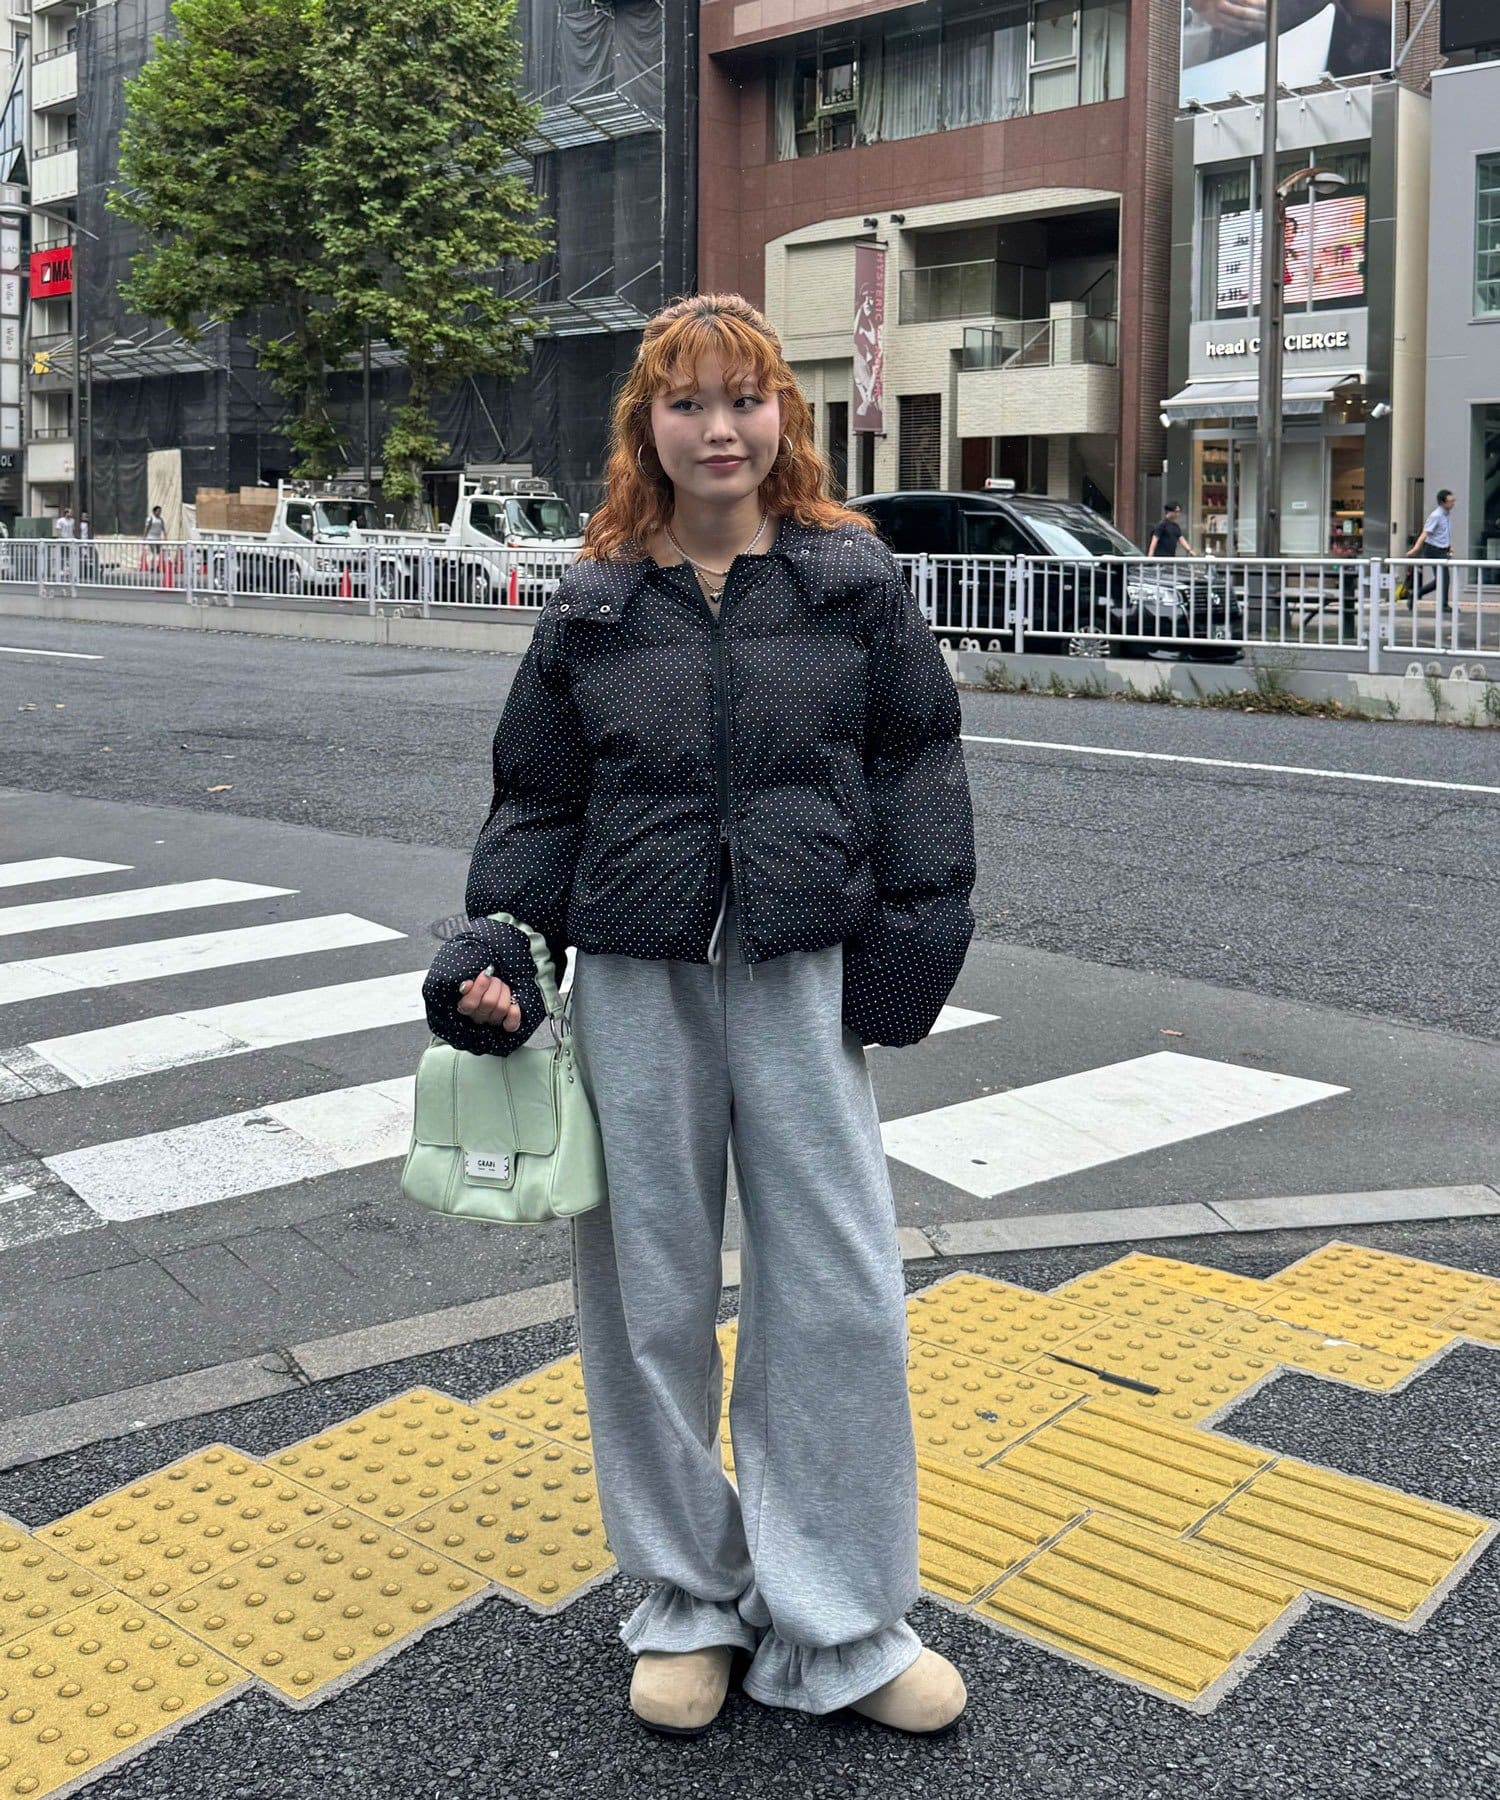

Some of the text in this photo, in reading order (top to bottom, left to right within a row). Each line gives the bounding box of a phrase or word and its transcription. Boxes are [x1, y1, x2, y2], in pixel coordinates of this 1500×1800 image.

[875, 252, 884, 321] HYSTERIC
[1206, 331, 1347, 356] head CCIERGE
